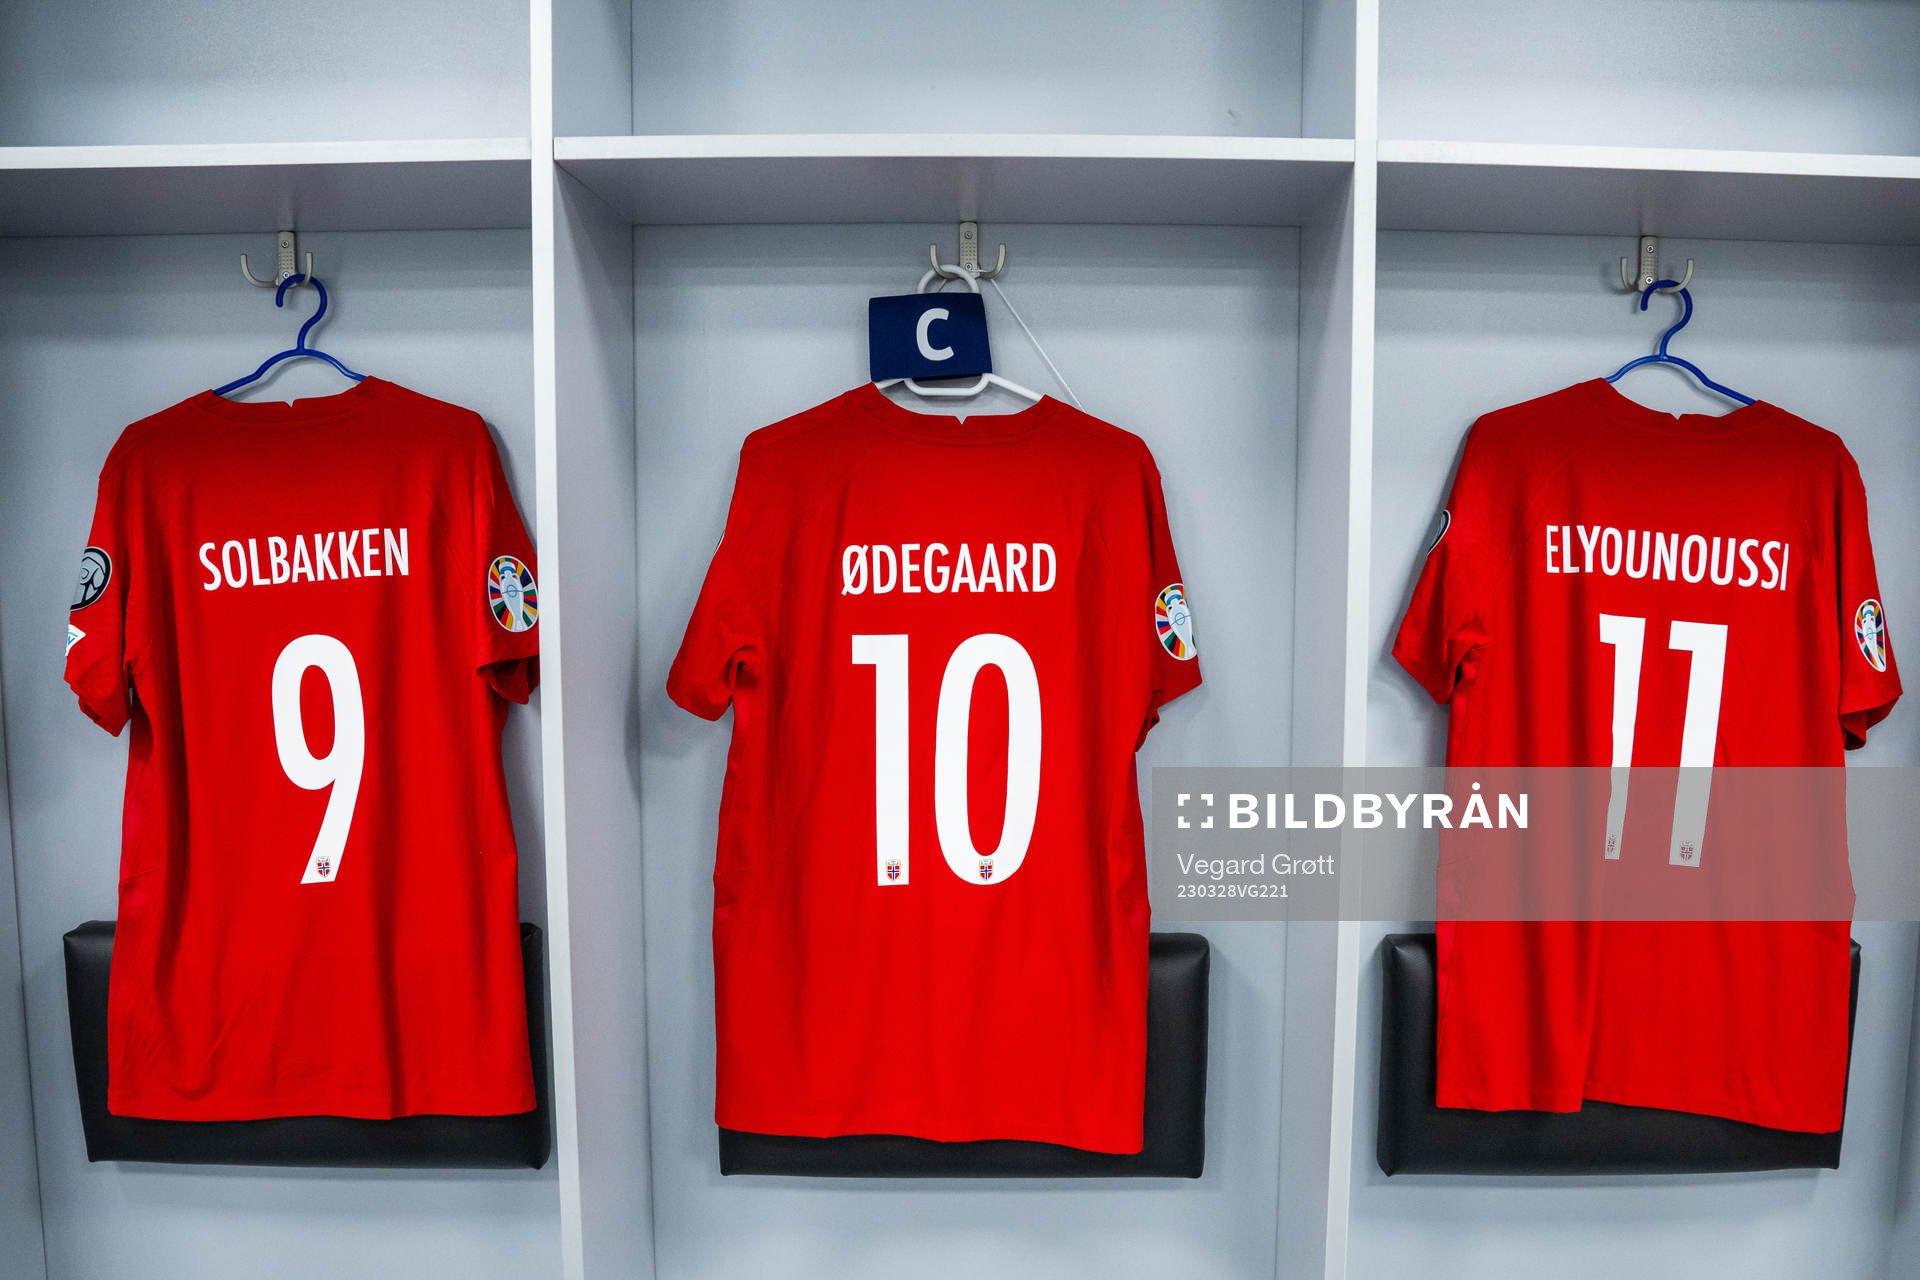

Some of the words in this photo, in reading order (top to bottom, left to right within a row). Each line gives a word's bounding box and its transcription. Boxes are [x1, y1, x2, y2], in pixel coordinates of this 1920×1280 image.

[916, 308, 954, 361] C
[198, 527, 409, 591] SOLBAKKEN
[841, 542, 1057, 596] ØDEGAARD
[1546, 524, 1790, 591] ELYOUNOUSSI
[271, 634, 366, 885] 9
[851, 633, 1042, 887] 10
[1599, 613, 1729, 868] 11
